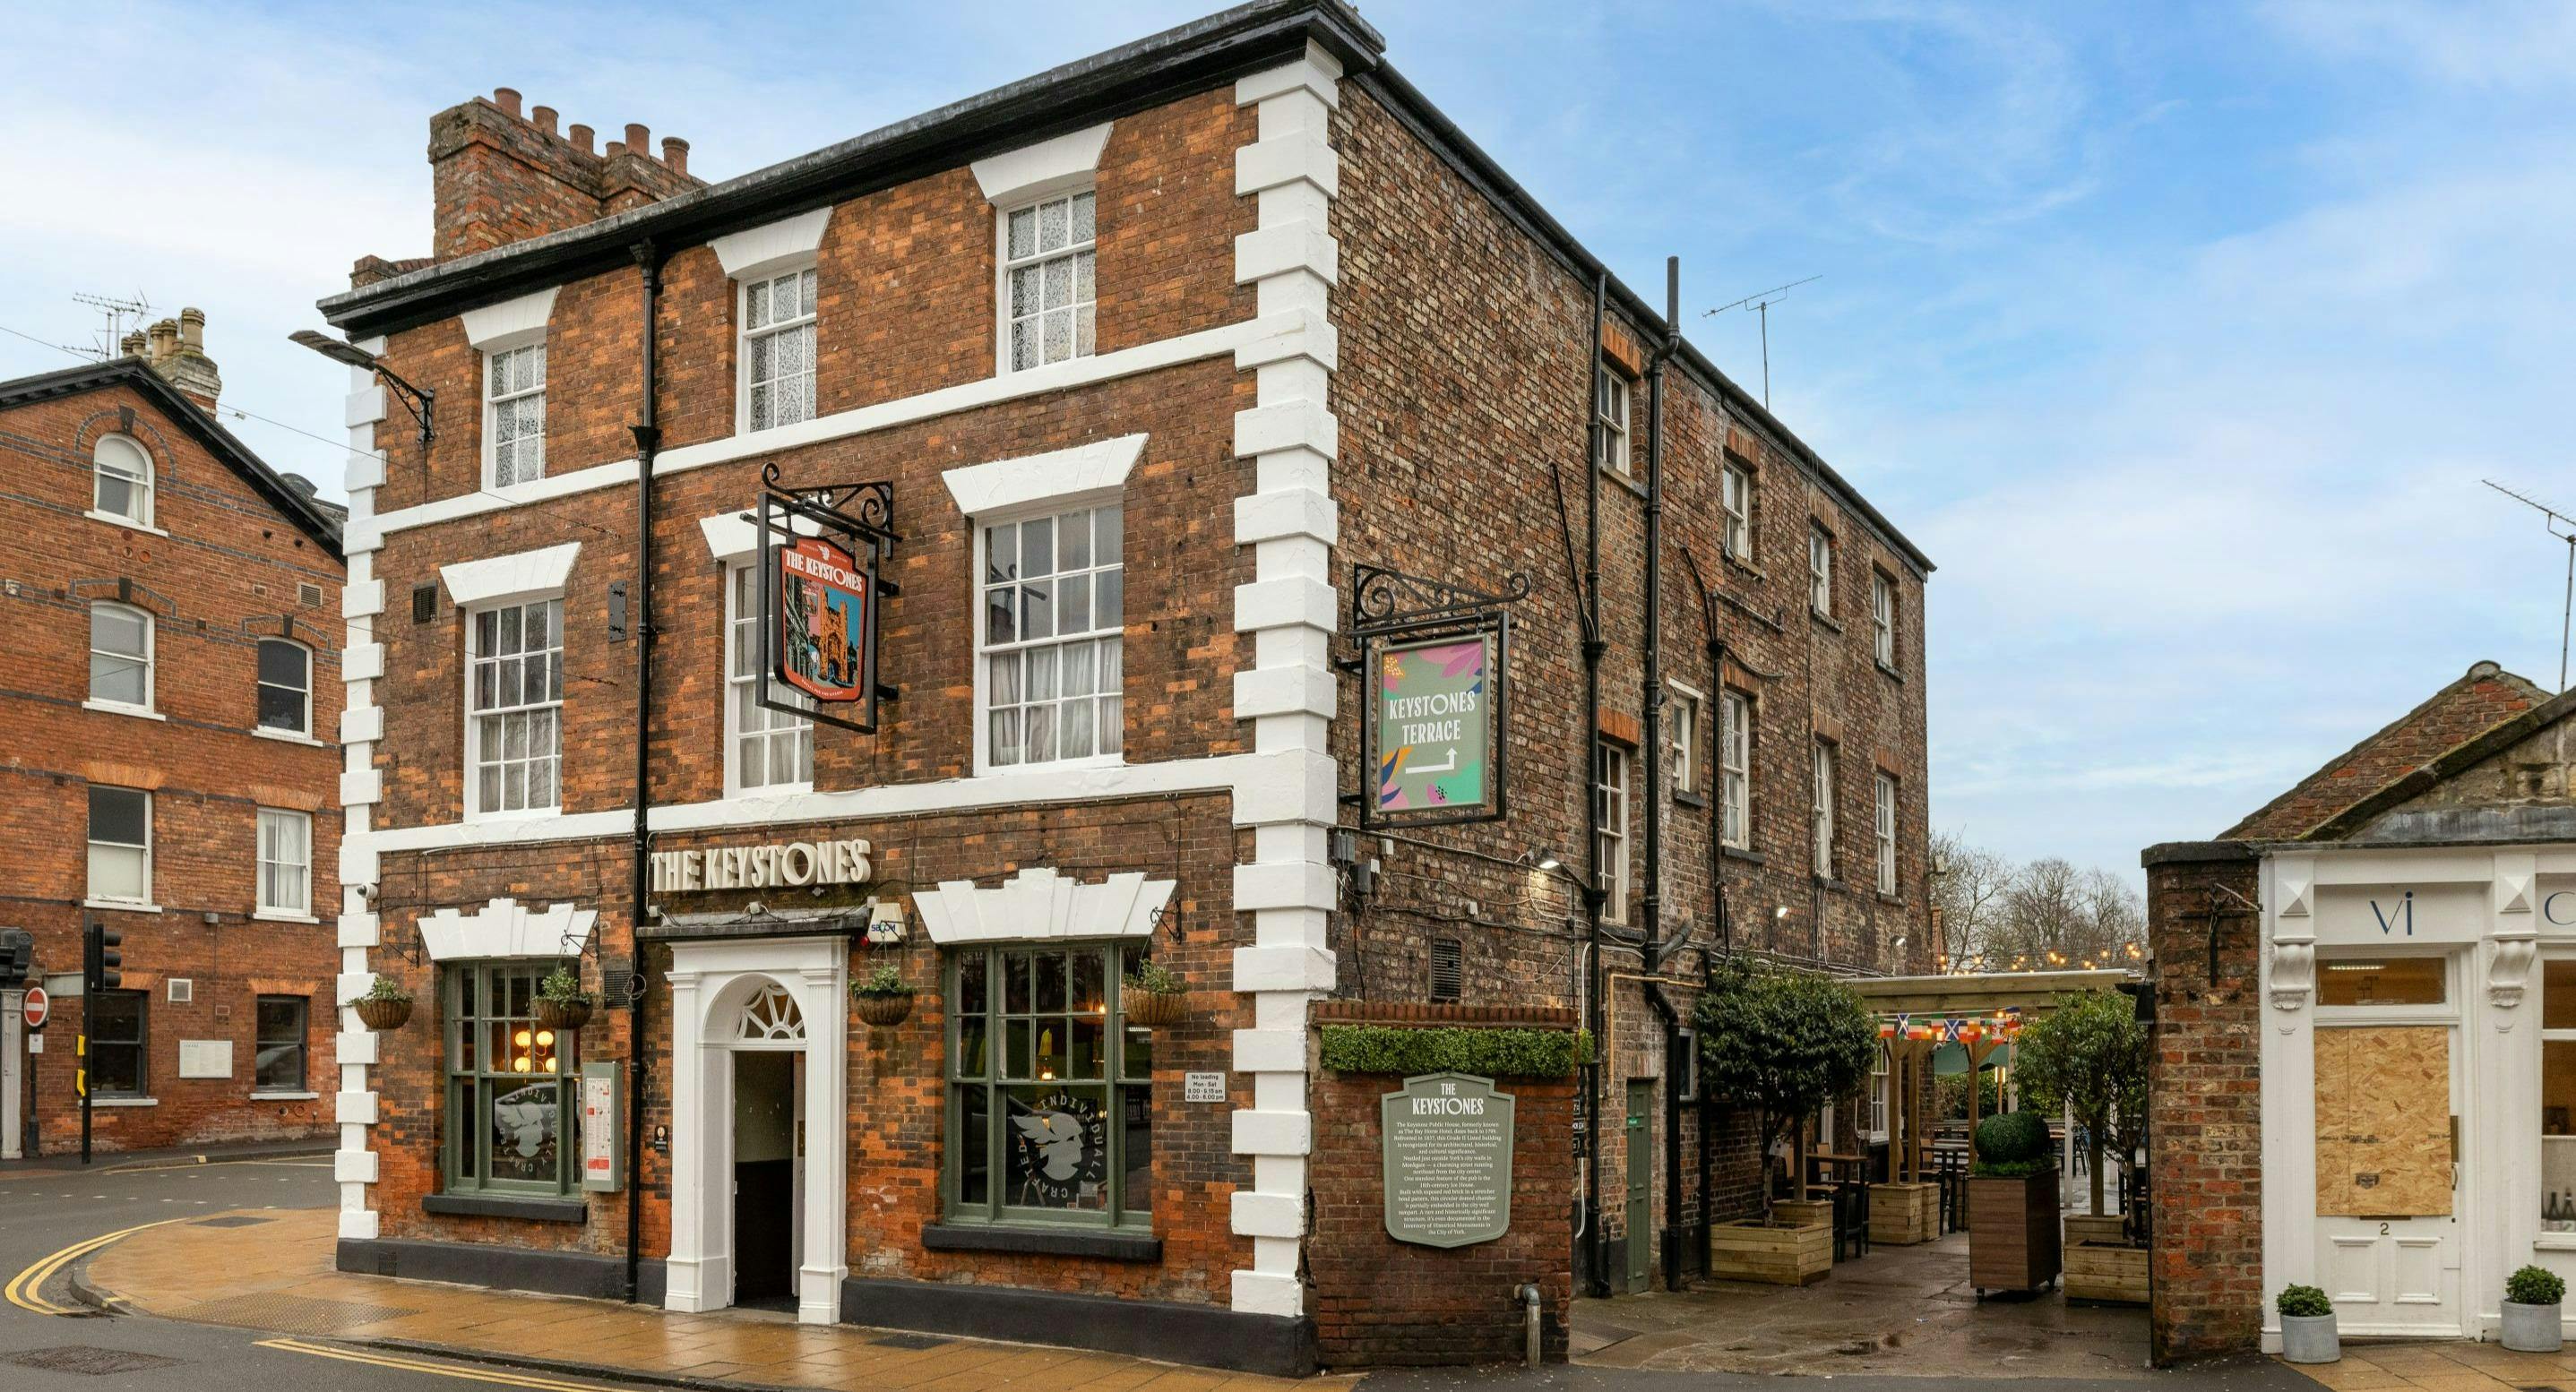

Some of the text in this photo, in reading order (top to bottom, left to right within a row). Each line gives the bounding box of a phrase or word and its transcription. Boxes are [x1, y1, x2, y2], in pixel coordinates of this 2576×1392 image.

[786, 550, 862, 592] THE KEYSTONES
[1389, 691, 1476, 720] KEYSTONES
[1402, 719, 1461, 745] TERRACE
[650, 839, 871, 892] THE KEYSTONES
[1441, 1083, 1456, 1096] THE
[1412, 1097, 1484, 1115] KEYSTONES
[1040, 1096, 1104, 1180] INDIVIDUALL
[1019, 1145, 1068, 1199] CRAFTED
[2380, 1222, 2390, 1236] 2
